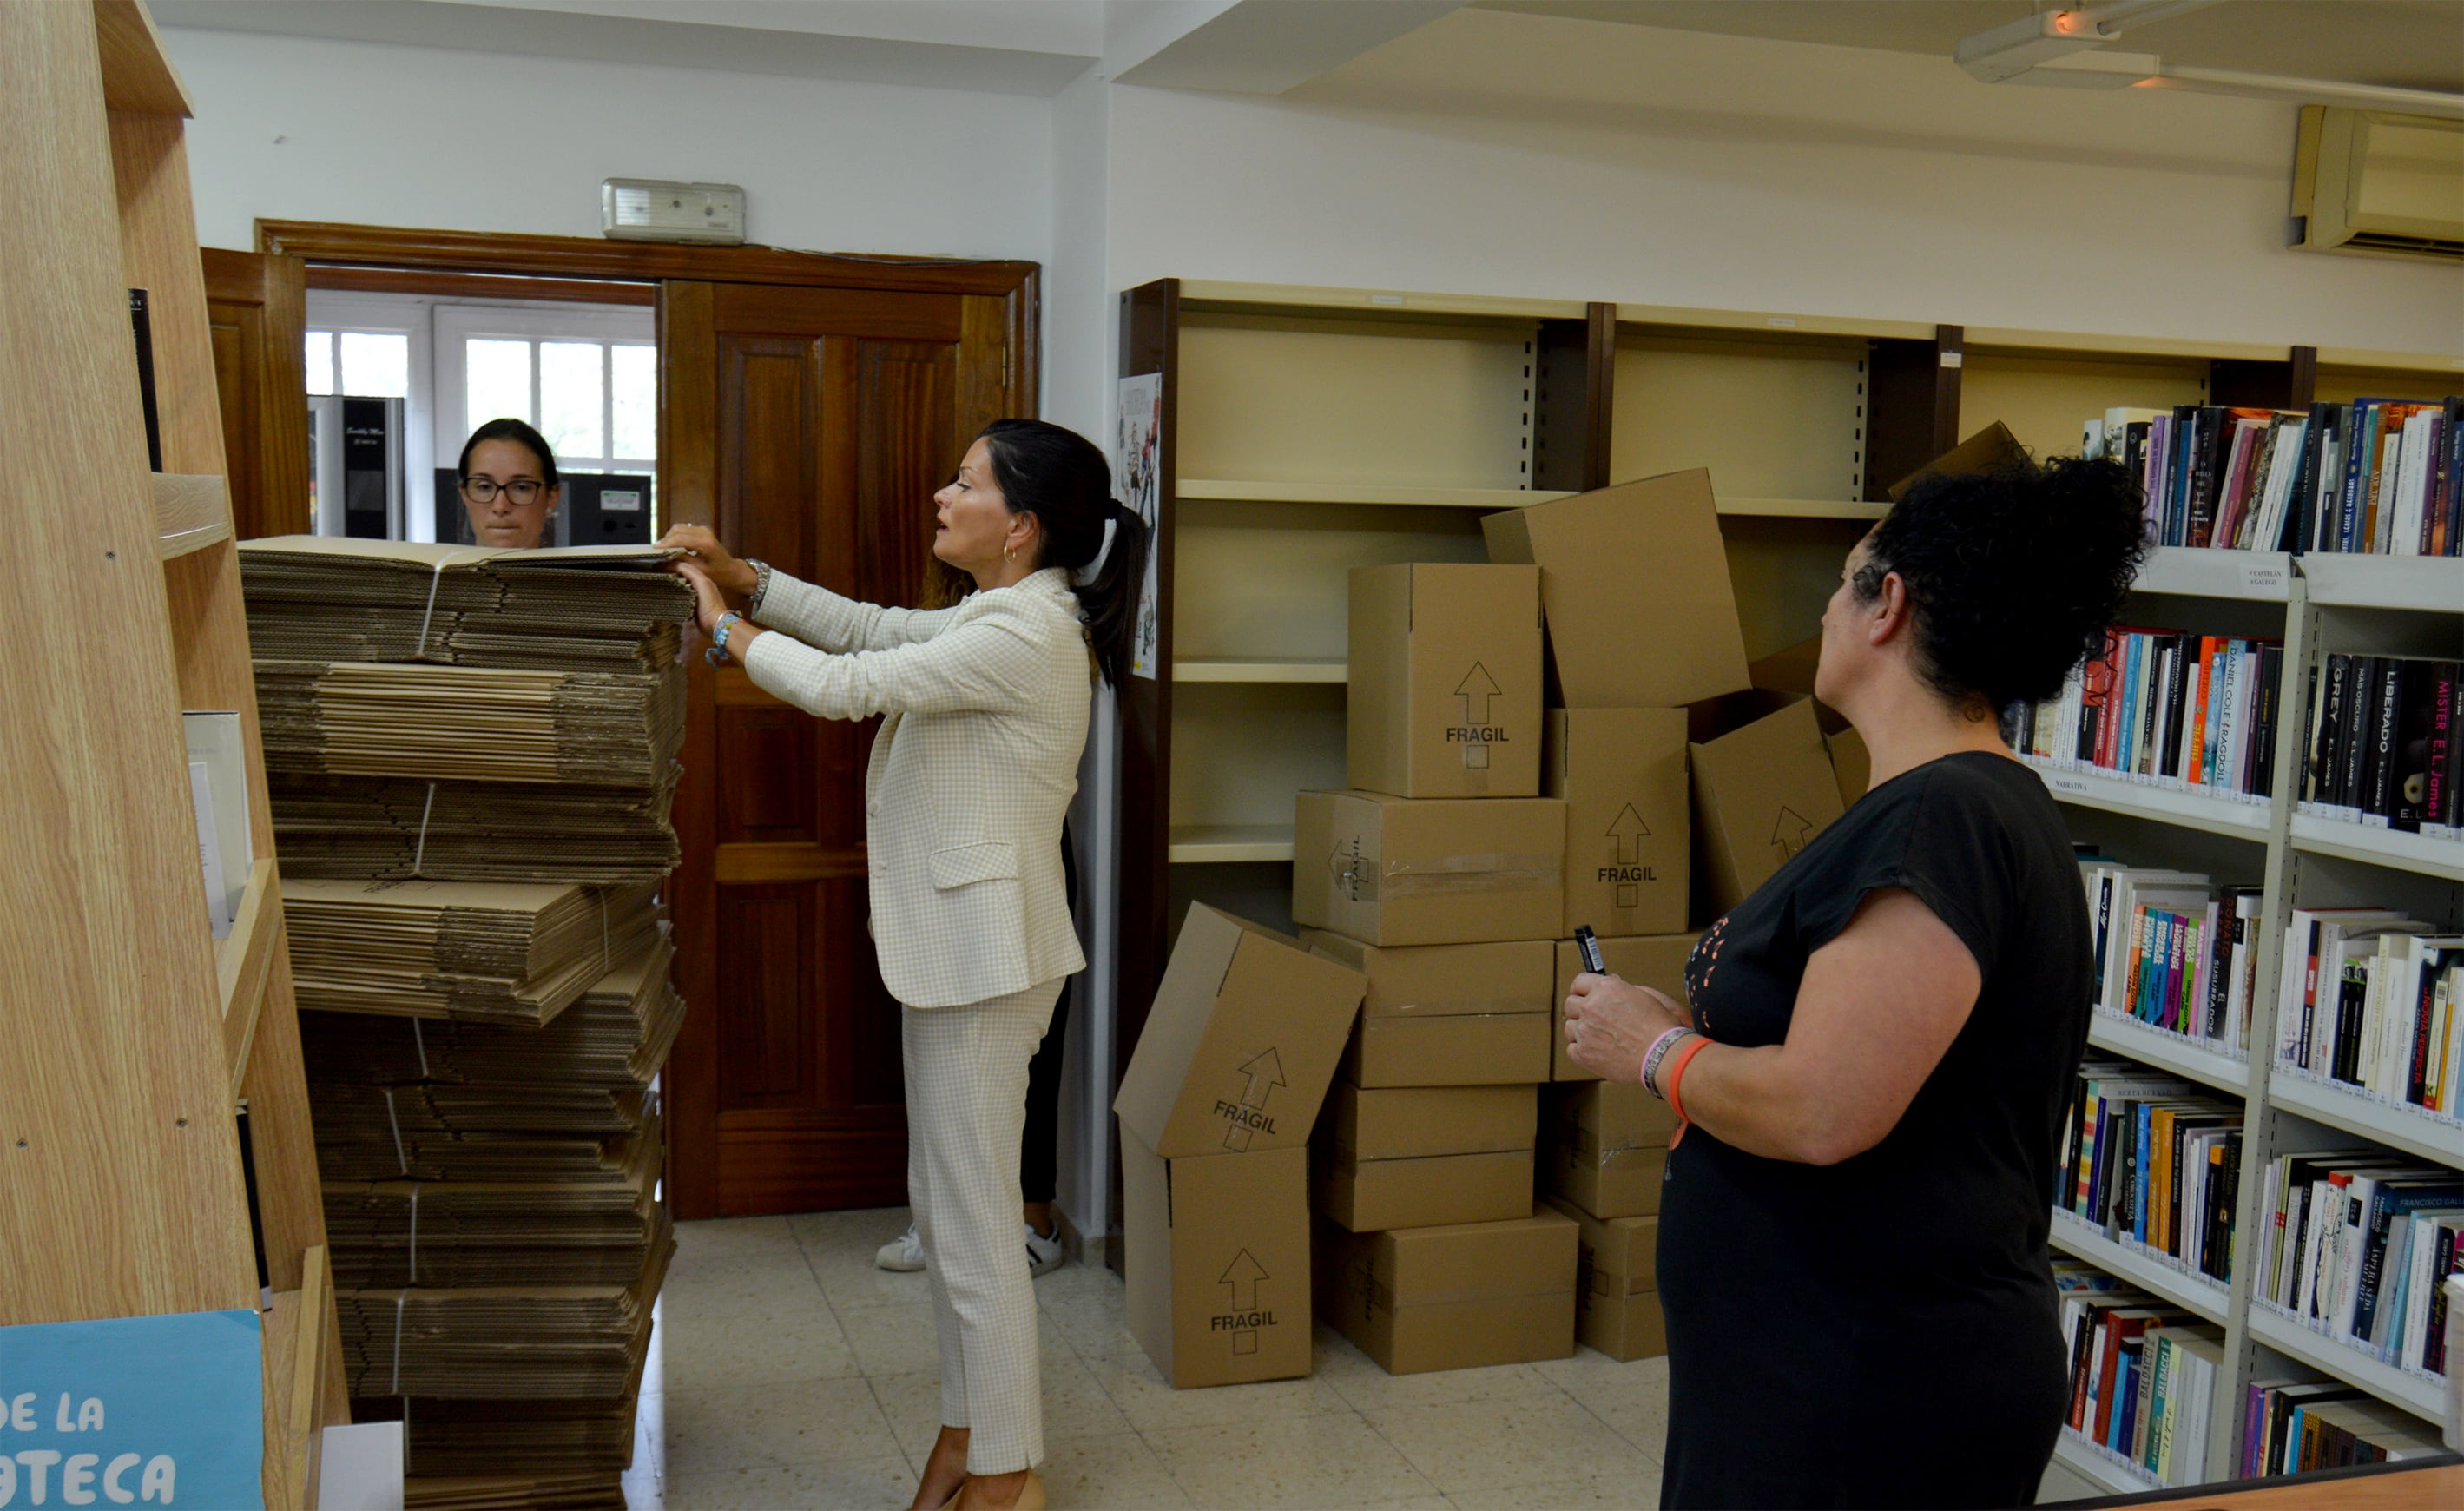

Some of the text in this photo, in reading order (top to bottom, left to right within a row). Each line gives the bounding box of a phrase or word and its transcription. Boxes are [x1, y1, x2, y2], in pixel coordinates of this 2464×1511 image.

[2202, 659, 2210, 700] COELHO
[2329, 667, 2342, 723] GREY
[2217, 646, 2237, 782] DANIEL COLE RAGDOLL
[2353, 690, 2362, 732] OSCURO
[2379, 670, 2396, 754] LIBERADO
[2435, 680, 2449, 730] MISTER
[1446, 727, 1509, 742] FRAGIL
[2191, 723, 2203, 762] HIPPIE
[2055, 780, 2087, 792] NARRATIVA
[2375, 777, 2383, 807] JAMES
[2428, 769, 2444, 818] James
[1351, 834, 1360, 902] FRAGIL
[1598, 867, 1657, 884] FRAGIL
[2159, 920, 2168, 953] ENDER
[2171, 923, 2180, 970] MUERTOS
[2223, 897, 2234, 957] DONATO
[2209, 959, 2220, 1033] SUSURRADOR
[2218, 993, 2225, 1003] EL
[2420, 993, 2431, 1032] NOVIA
[2415, 1033, 2426, 1084] PERFECTA
[1213, 1099, 1277, 1136] FRAGIL
[2371, 1195, 2380, 1230] GALLARDO
[2375, 1196, 2386, 1233] FRANCISCO
[2400, 1198, 2442, 1207] FRANCISCO
[1584, 1247, 1595, 1311] FRAGIL
[2363, 1287, 2375, 1311] SEDA
[1210, 1310, 1278, 1332] FRAGIL
[2140, 1348, 2154, 1400] BALDACCI
[2158, 1351, 2171, 1399] BALDACCI
[56, 1392, 104, 1432] LA
